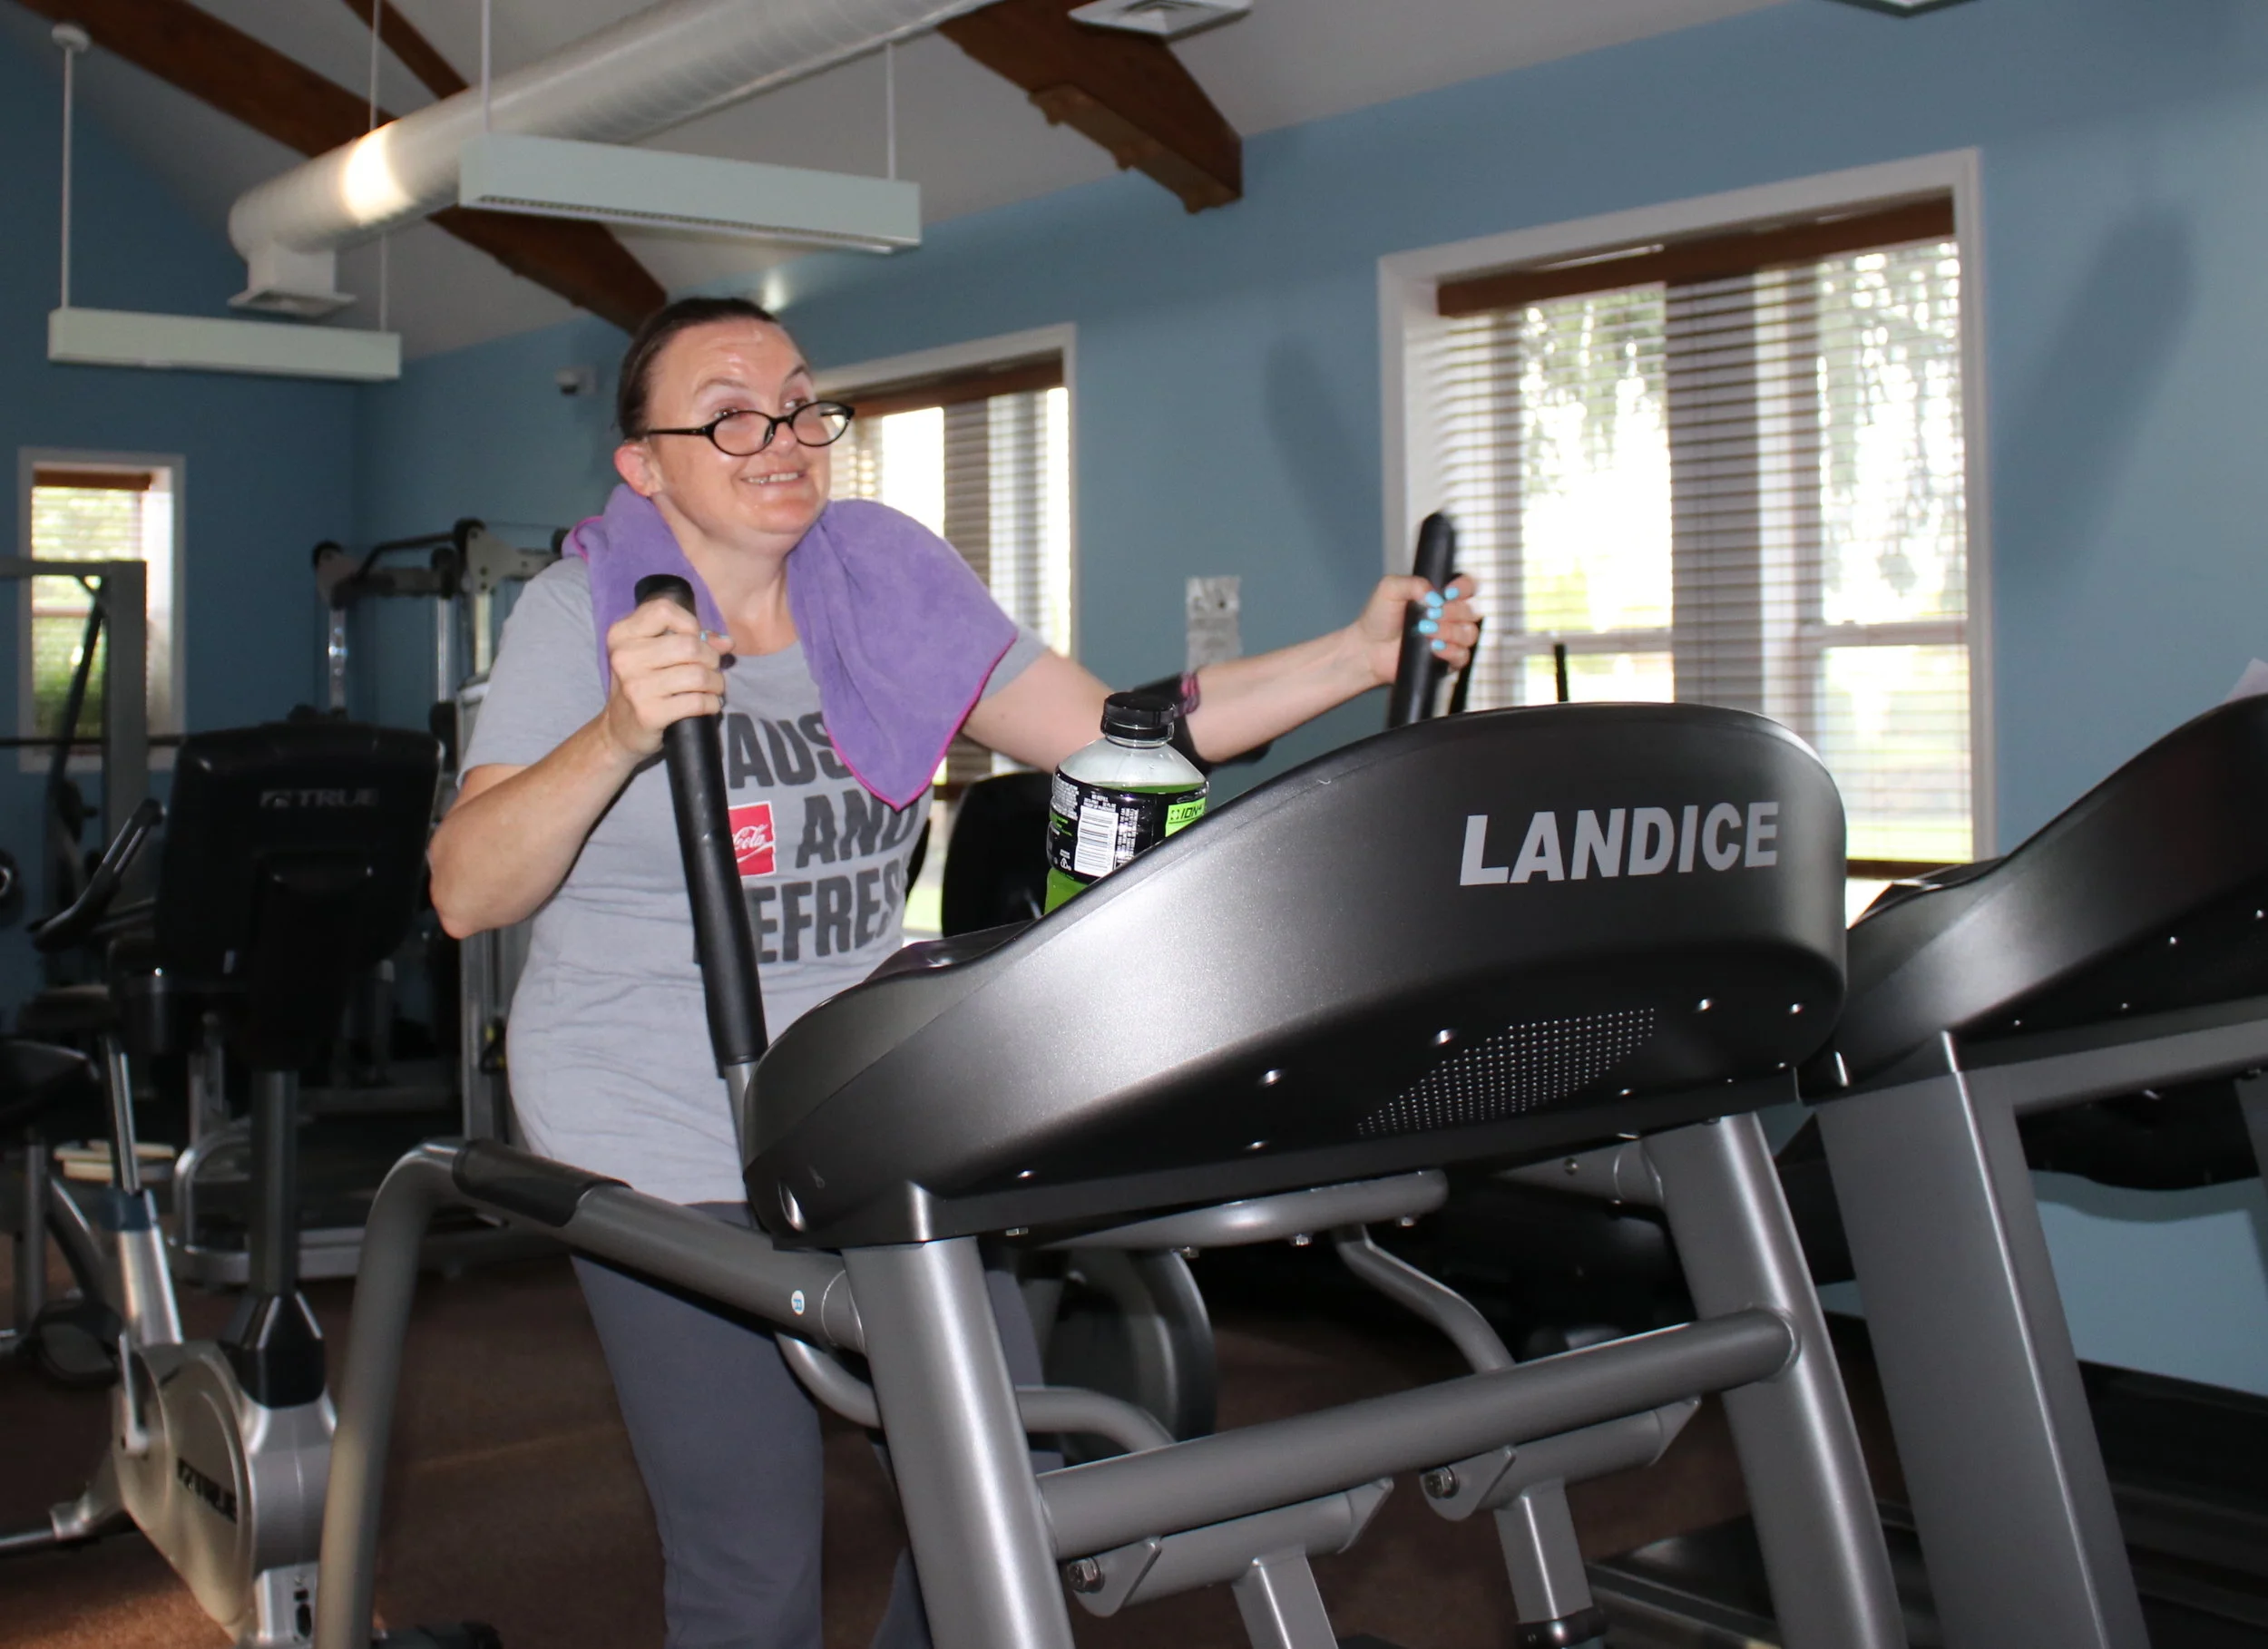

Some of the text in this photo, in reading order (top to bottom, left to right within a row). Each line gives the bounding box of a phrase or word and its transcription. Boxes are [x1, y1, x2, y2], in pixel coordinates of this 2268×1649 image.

[727, 711, 854, 789] AUS
[300, 787, 378, 808] TRUE
[796, 789, 919, 868] AND
[1459, 801, 1780, 886] LANDICE
[693, 858, 905, 964] EFRES
